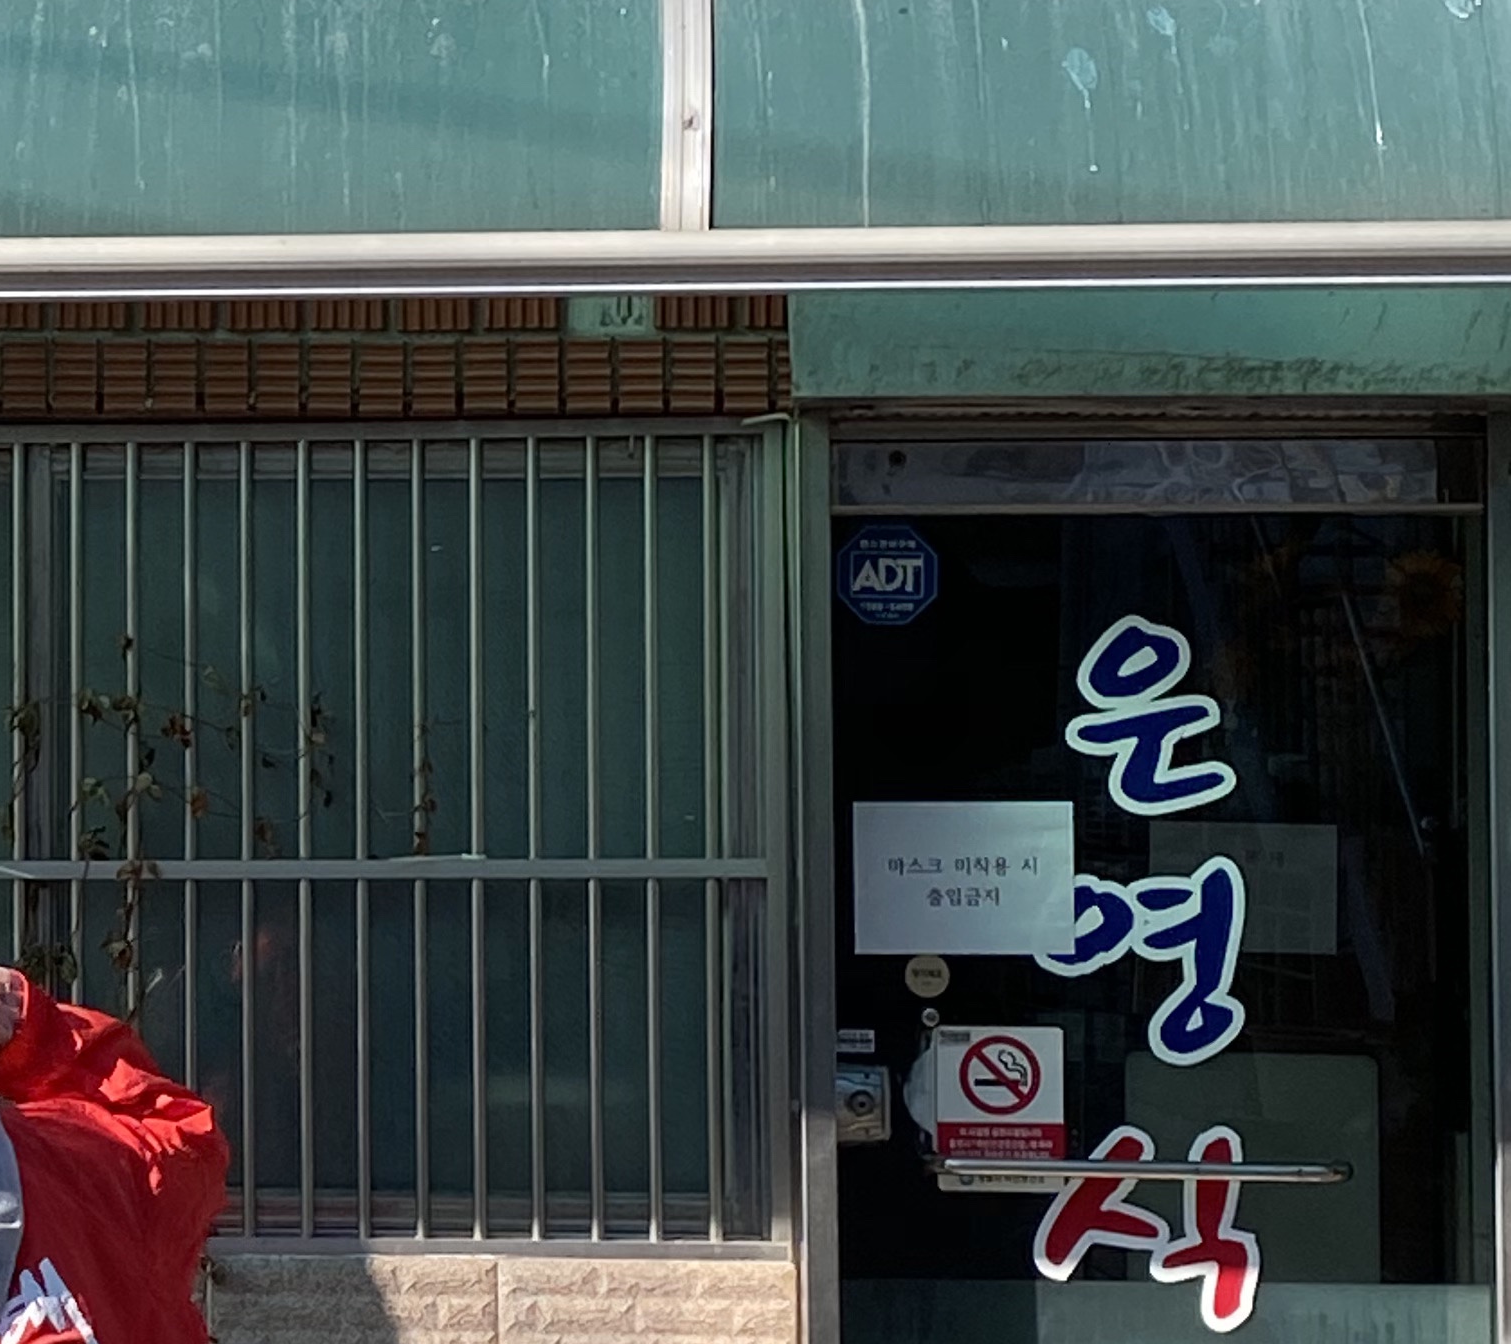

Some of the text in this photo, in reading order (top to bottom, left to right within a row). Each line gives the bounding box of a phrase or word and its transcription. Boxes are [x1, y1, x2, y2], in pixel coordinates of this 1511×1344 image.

[851, 557, 922, 593] ADT
[887, 856, 1039, 878] 마스크 미착용 시
[926, 887, 1001, 907] 출입금지
